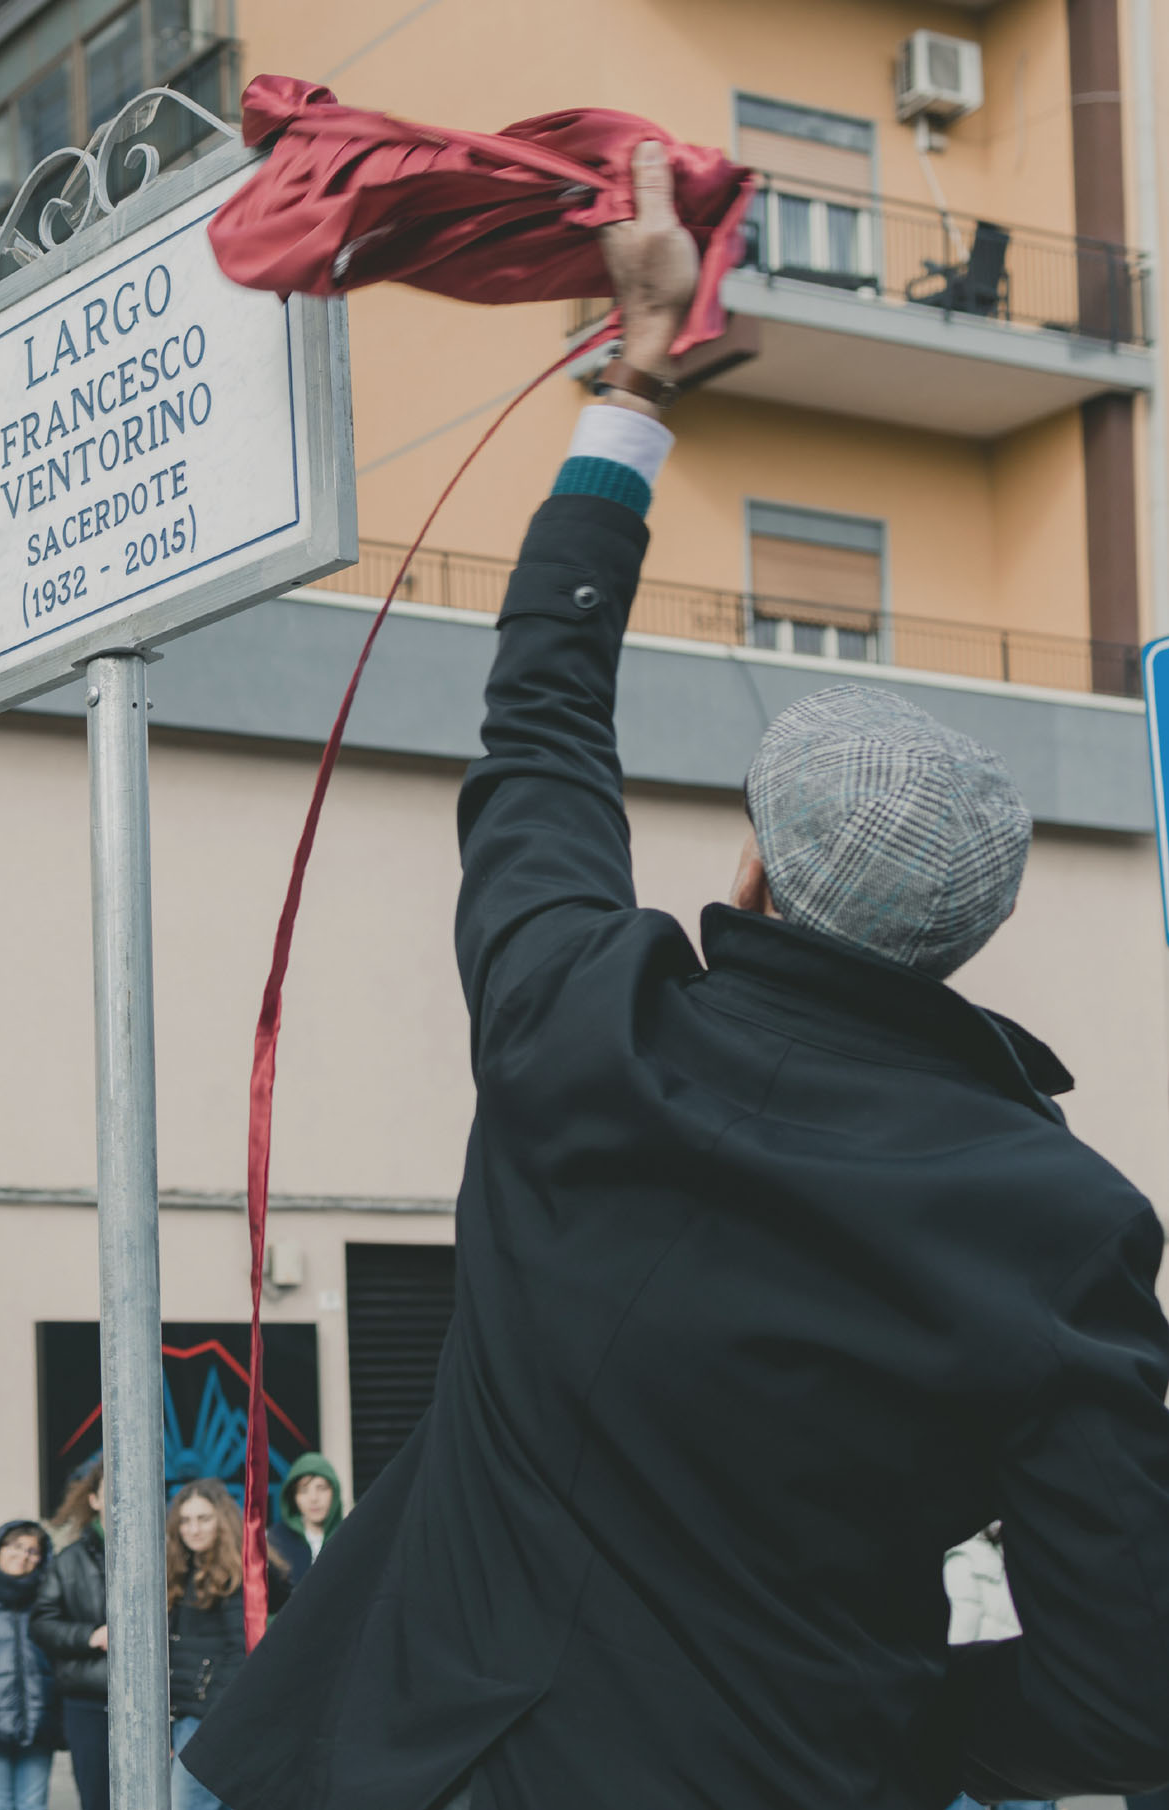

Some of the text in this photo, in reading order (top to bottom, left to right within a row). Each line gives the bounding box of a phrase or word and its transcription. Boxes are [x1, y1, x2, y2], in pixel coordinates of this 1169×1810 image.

[23, 263, 173, 391] LARGO
[0, 323, 207, 470] FRANCESCO
[21, 564, 88, 629] (1932
[124, 503, 197, 577] 2015)
[26, 459, 189, 568] SACERDOTE
